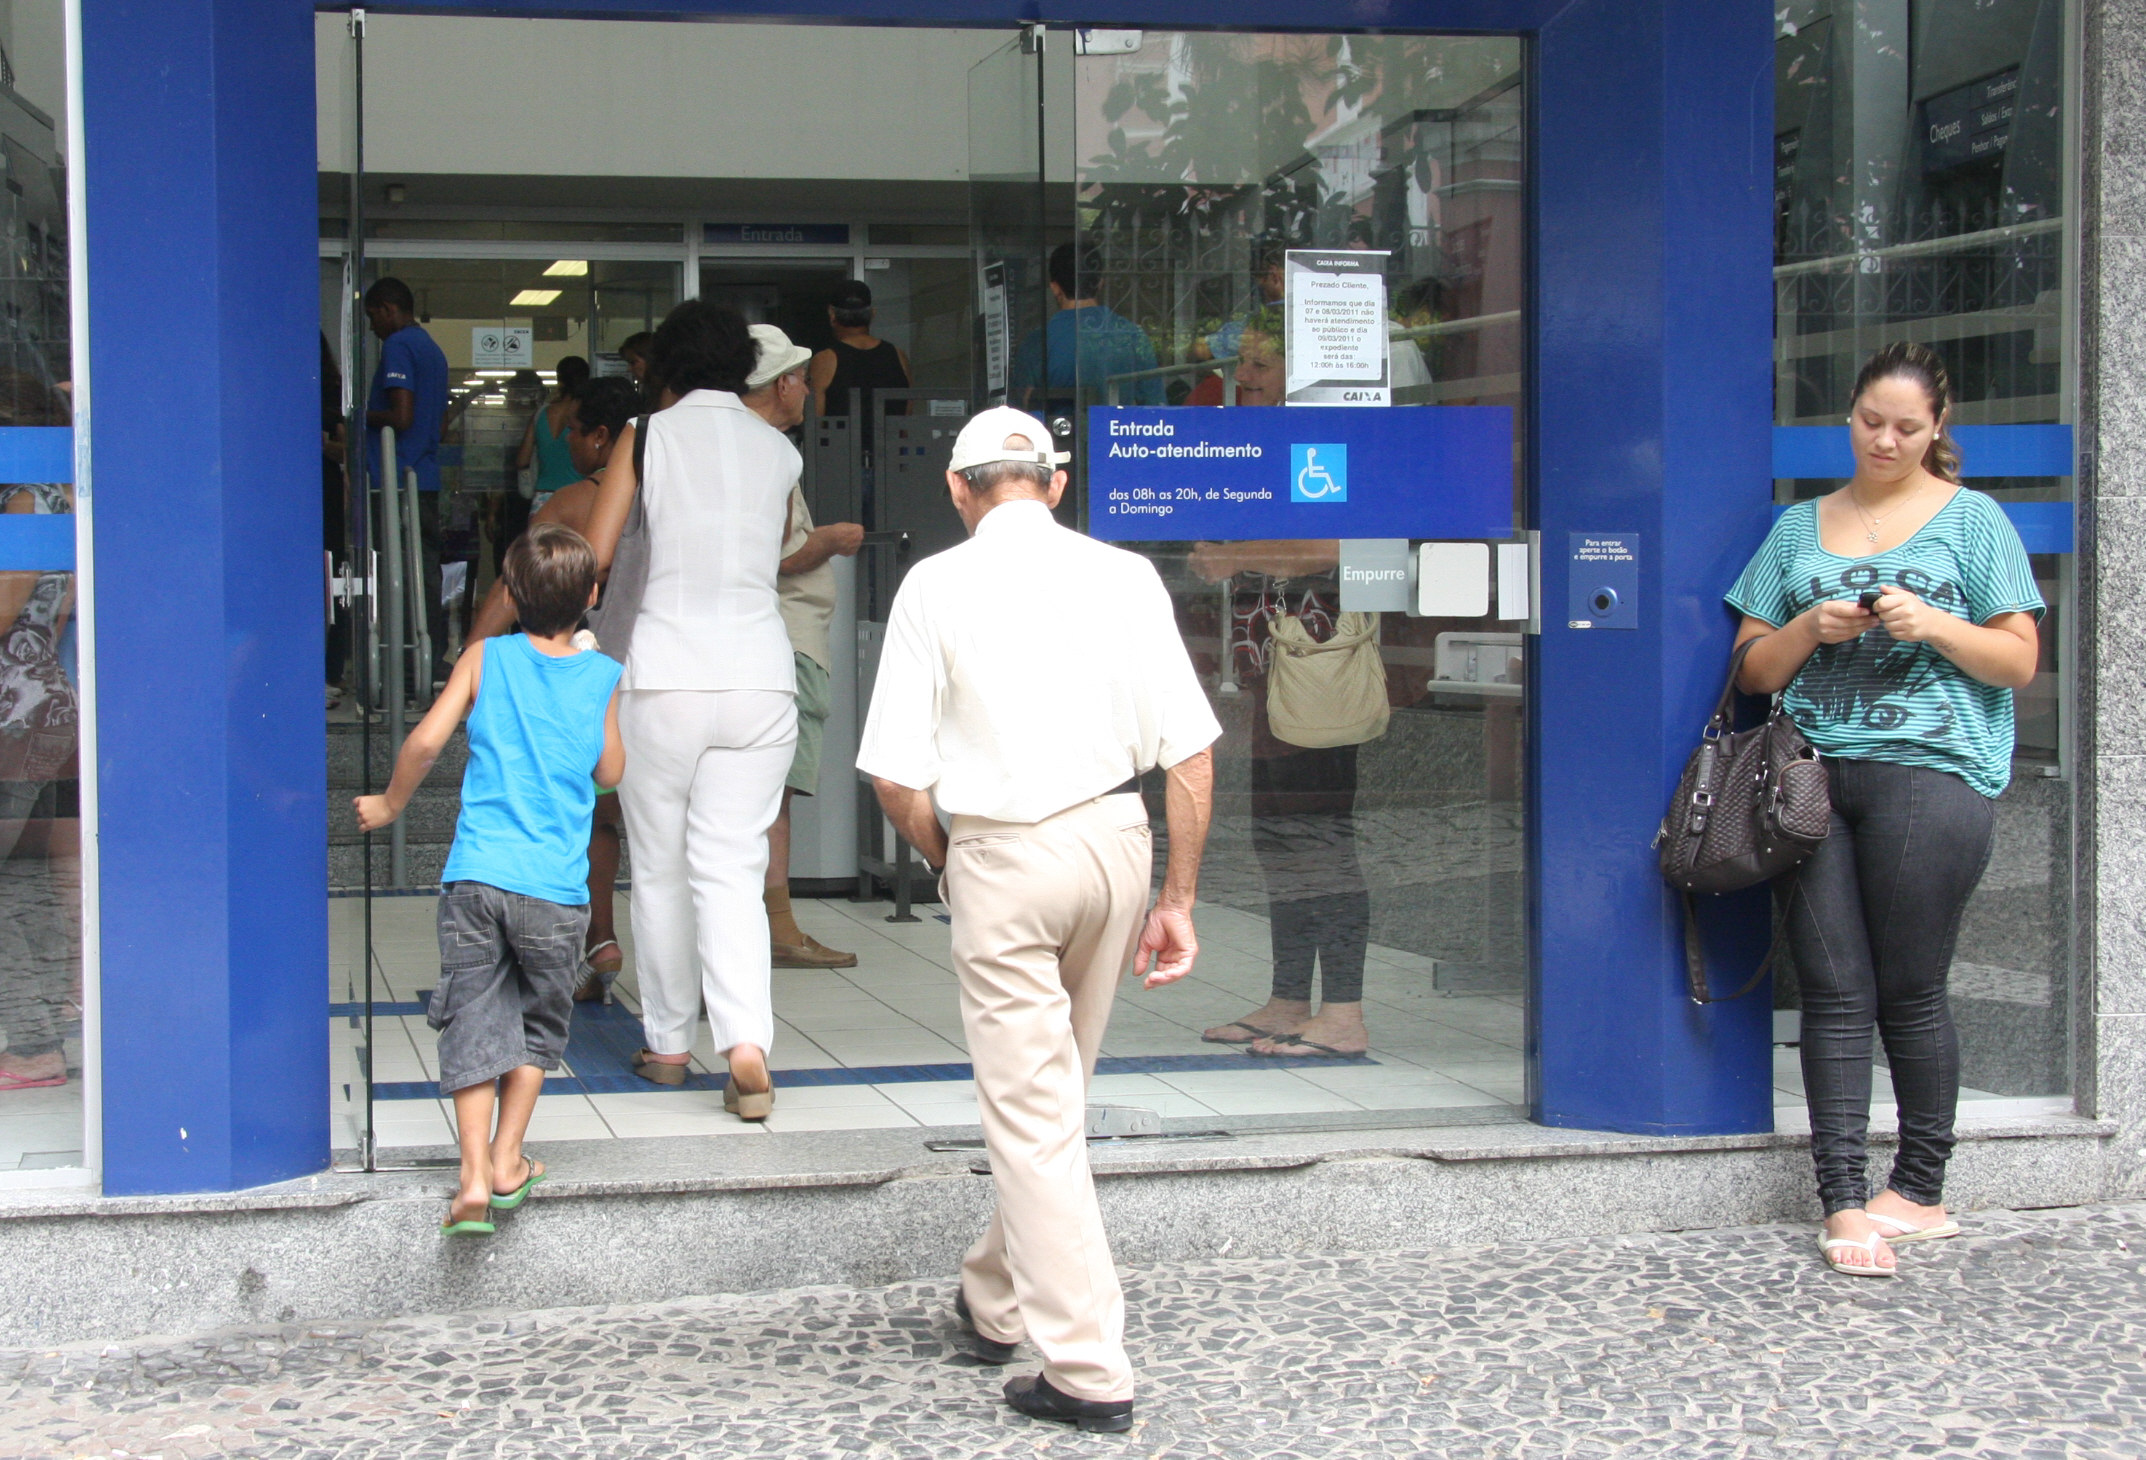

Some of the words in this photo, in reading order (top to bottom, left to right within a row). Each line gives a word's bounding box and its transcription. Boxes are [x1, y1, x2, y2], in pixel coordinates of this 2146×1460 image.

[1930, 120, 1960, 144] Cheques
[741, 225, 804, 242] Entrada
[1316, 259, 1333, 267] CAIXA
[1310, 280, 1340, 289] Prezado
[1342, 281, 1369, 290] Cliente,
[1304, 298, 1347, 307] Informamos
[1349, 300, 1362, 308] que
[1364, 299, 1376, 307] dia
[1361, 308, 1374, 316] não
[1304, 316, 1329, 324] haverá
[1330, 317, 1375, 325] atendimento
[1322, 325, 1348, 334] público
[1357, 326, 1368, 334] dia
[1320, 344, 1359, 352] expediente
[1311, 361, 1334, 369] 12:00h
[1343, 391, 1382, 402] CAIXA
[1109, 419, 1175, 437] Entrada
[1109, 441, 1263, 458] Auto-atendimento
[1109, 488, 1129, 500] das
[1132, 488, 1156, 500] 08h
[1159, 490, 1172, 500] as
[1175, 488, 1202, 502] 20h,
[1205, 488, 1220, 500] de
[1223, 487, 1273, 503] Segunda
[1109, 504, 1117, 515] a
[1120, 502, 1173, 517] Domingo
[1585, 538, 1600, 547] Para
[1579, 547, 1600, 555] aperte
[1608, 546, 1628, 554] botão
[1580, 554, 1607, 562] empurre
[1614, 554, 1633, 562] porta
[1343, 565, 1405, 585] Empurre
